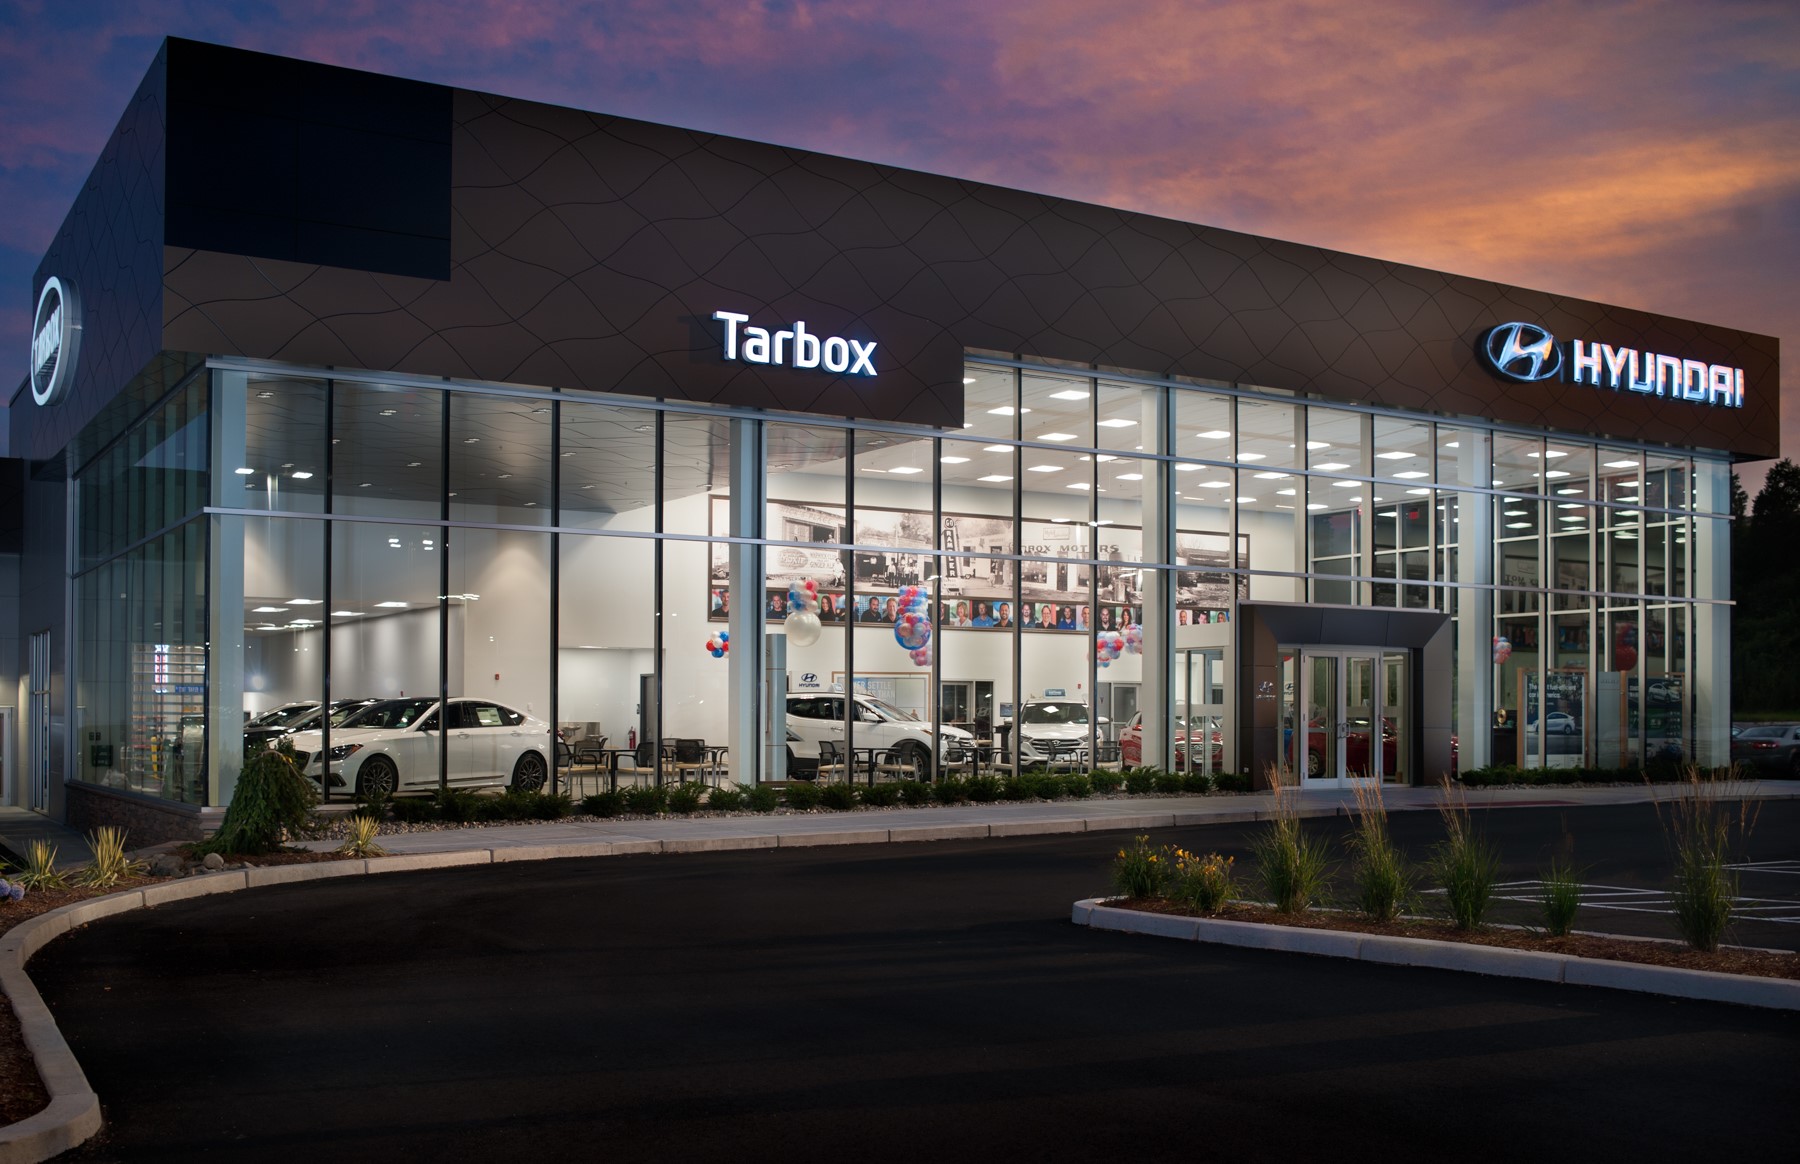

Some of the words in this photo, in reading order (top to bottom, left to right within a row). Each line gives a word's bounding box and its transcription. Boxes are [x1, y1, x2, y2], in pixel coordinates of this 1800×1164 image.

[712, 310, 878, 377] Tarbox
[1573, 338, 1745, 409] HYUNDAI
[945, 530, 956, 577] RAMLER
[1059, 543, 1121, 554] MOTRS
[867, 680, 892, 690] SETTLE
